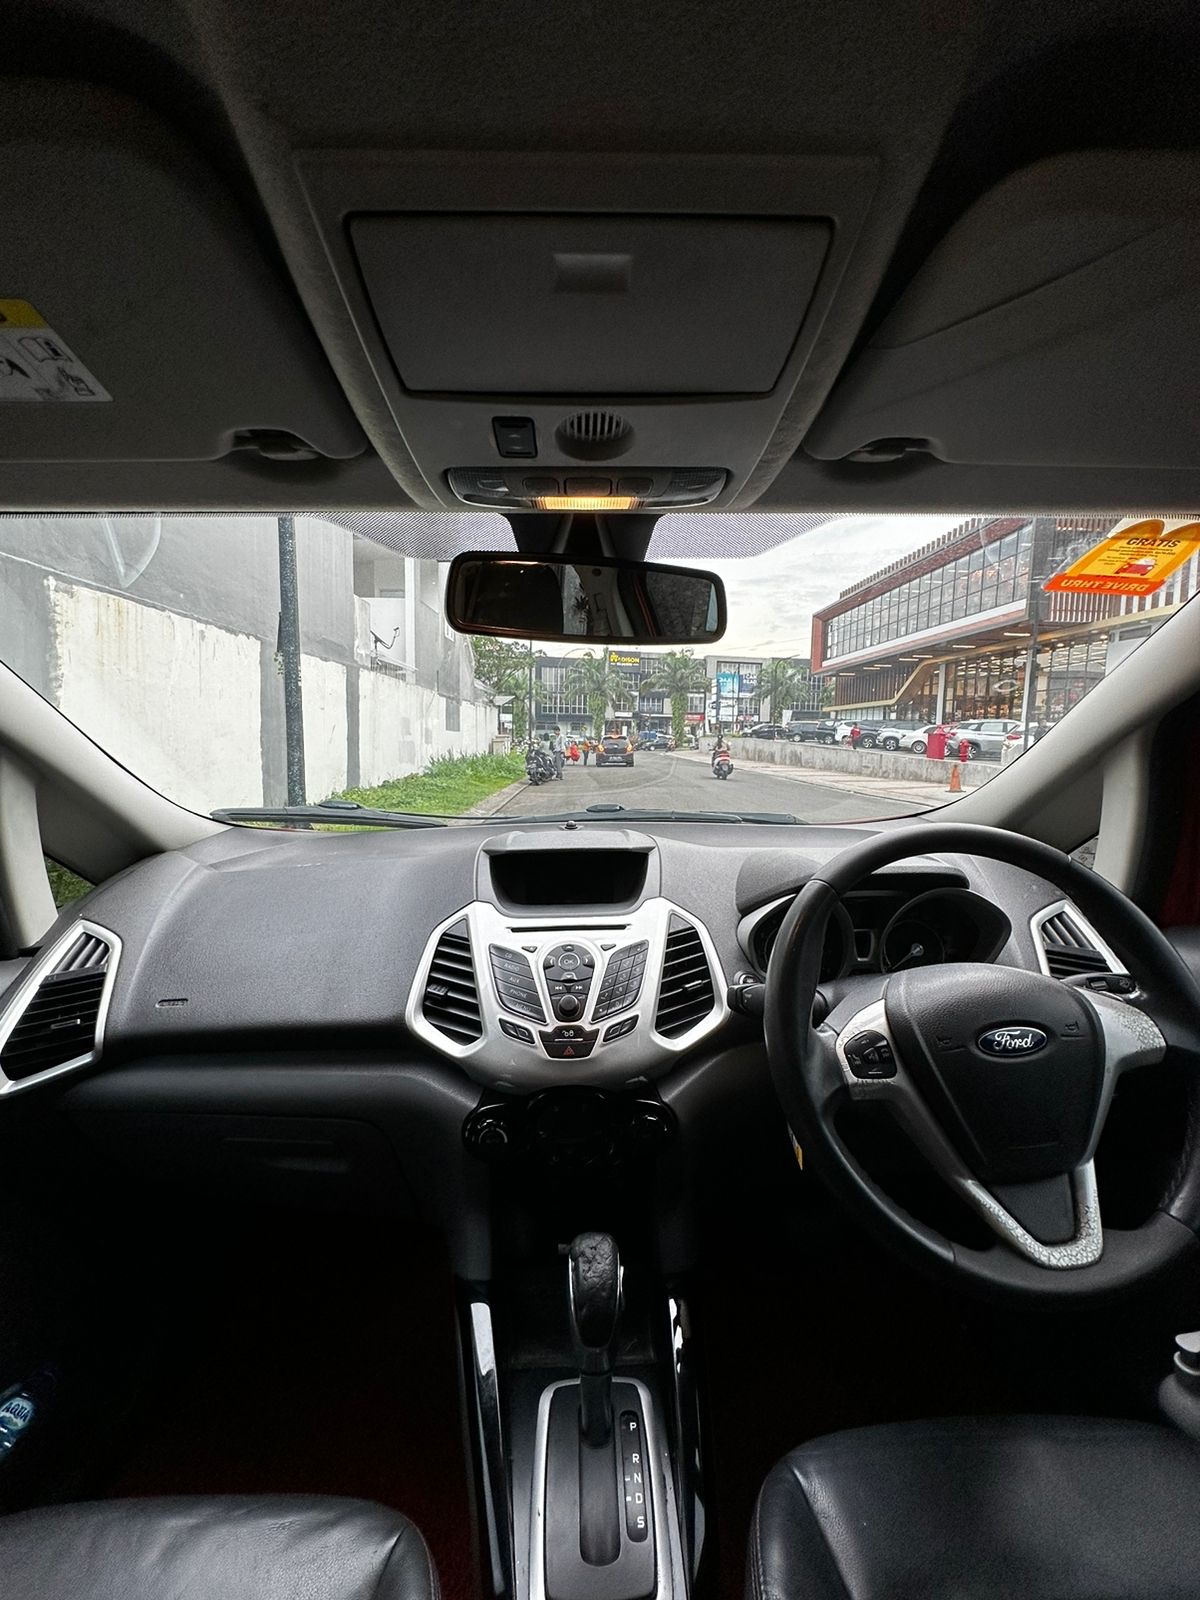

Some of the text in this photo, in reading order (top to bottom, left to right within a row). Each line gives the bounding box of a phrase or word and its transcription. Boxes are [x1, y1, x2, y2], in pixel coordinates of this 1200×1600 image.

[1126, 538, 1180, 548] GRATIS
[509, 988, 528, 998] PHONE
[993, 1030, 1035, 1050] Ford
[2, 1401, 29, 1421] AQUA
[629, 1422, 637, 1432] P
[632, 1453, 640, 1464] R
[633, 1472, 642, 1483] N
[635, 1492, 643, 1504] D
[636, 1516, 645, 1529] S
